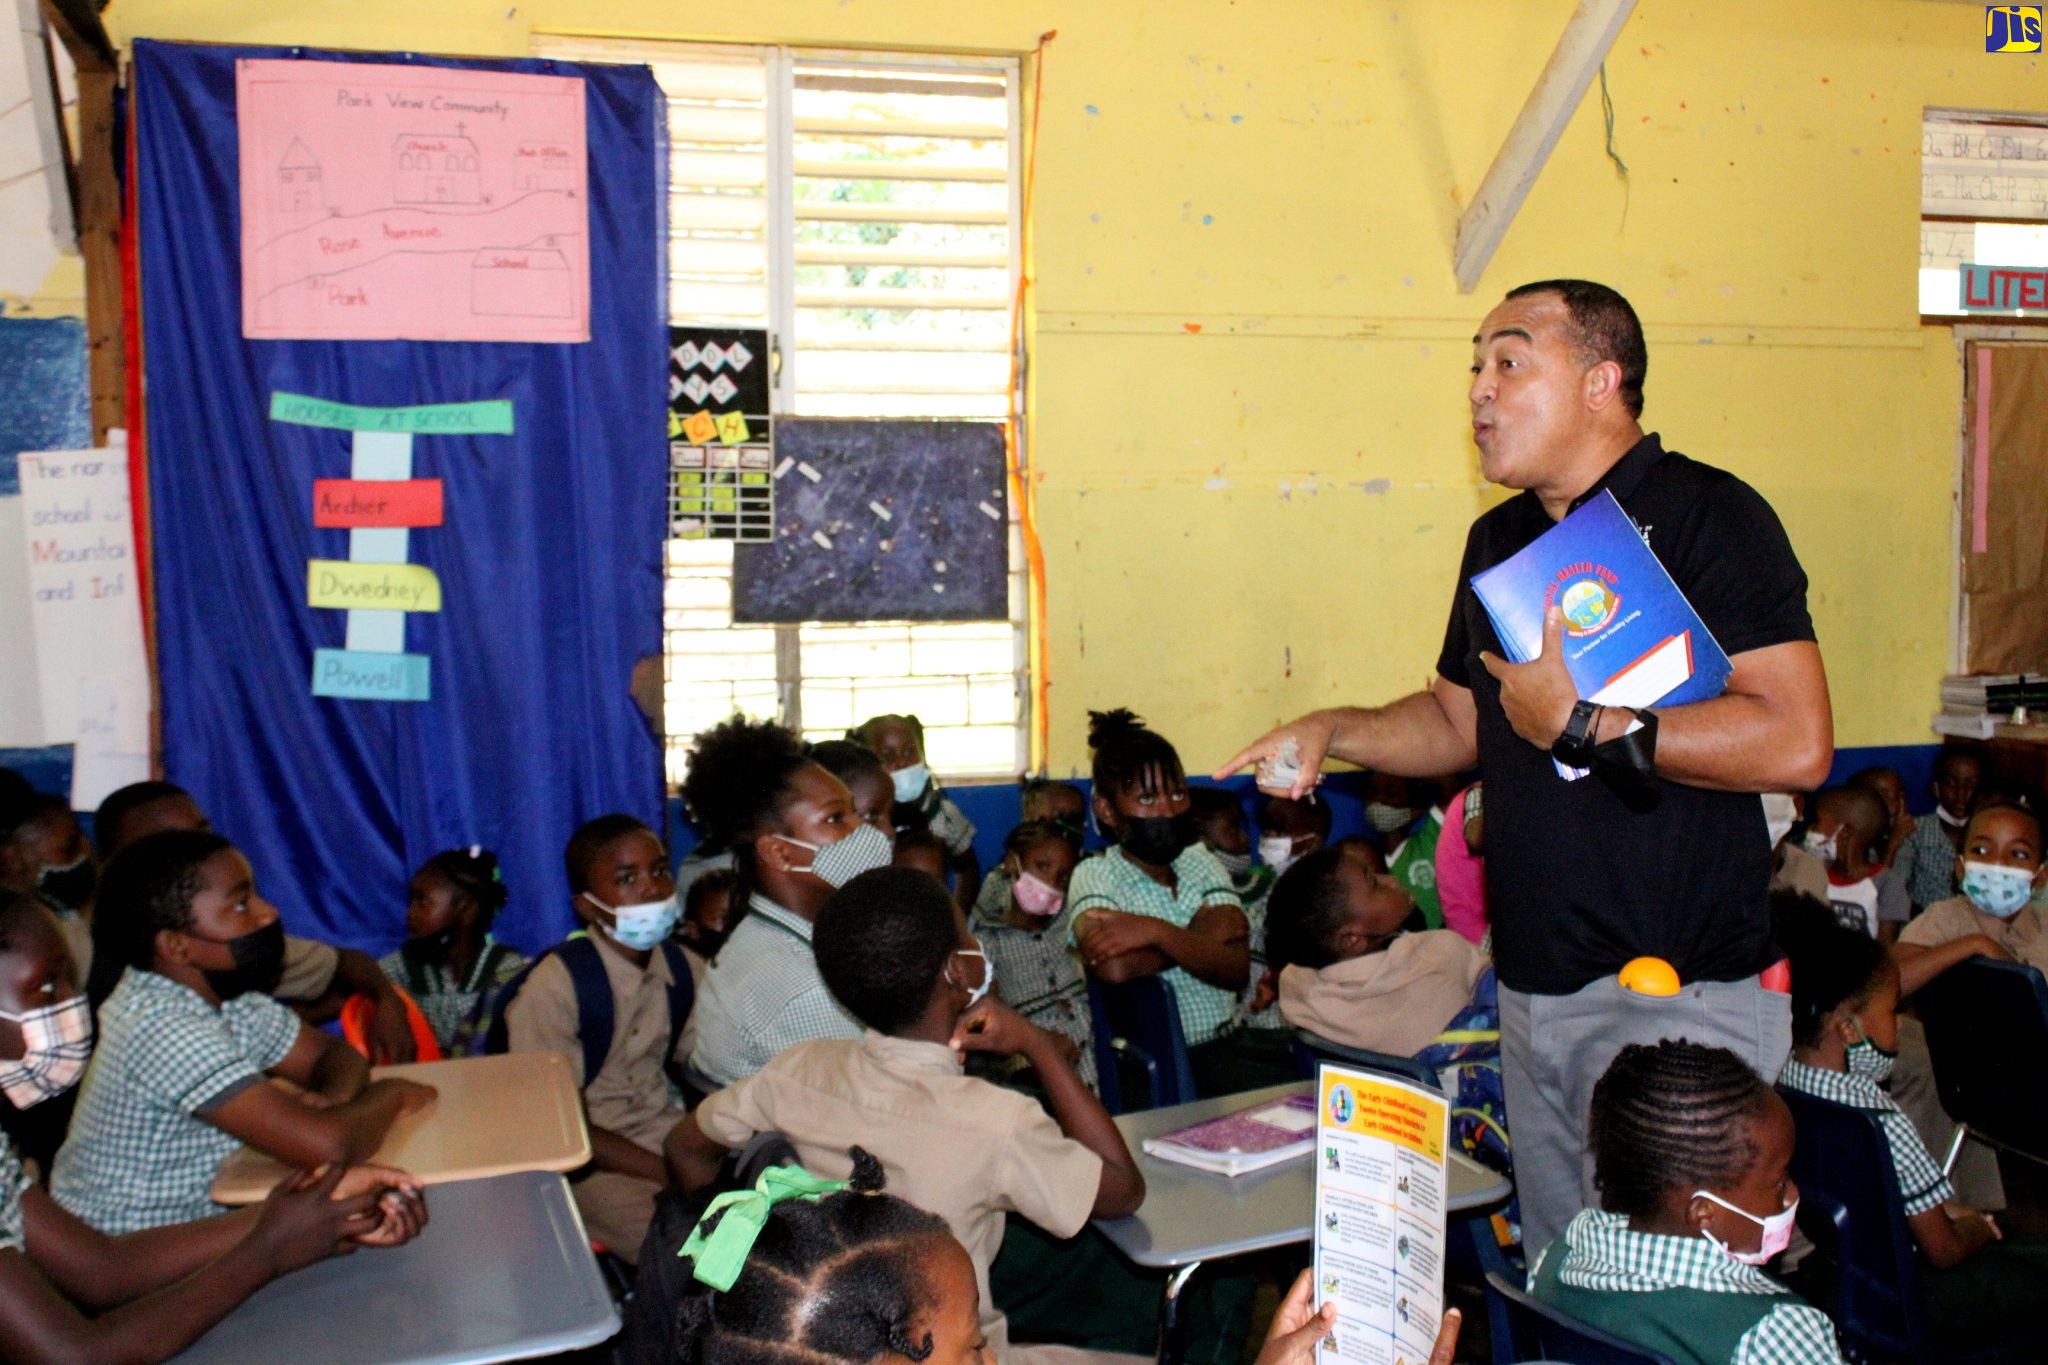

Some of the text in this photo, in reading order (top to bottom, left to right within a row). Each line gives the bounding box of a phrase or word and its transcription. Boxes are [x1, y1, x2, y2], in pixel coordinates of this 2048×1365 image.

[337, 88, 509, 121] Park View Community
[319, 222, 444, 256] Rose Avenue
[328, 285, 369, 307] Park
[1966, 269, 2048, 308] LITE
[284, 402, 479, 428] HOUSES AT SCHOOL
[319, 493, 388, 516] Archer
[1556, 561, 1592, 582] HEALTH
[1594, 563, 1619, 585] FUND
[36, 579, 75, 601] and
[322, 659, 402, 691] Powell
